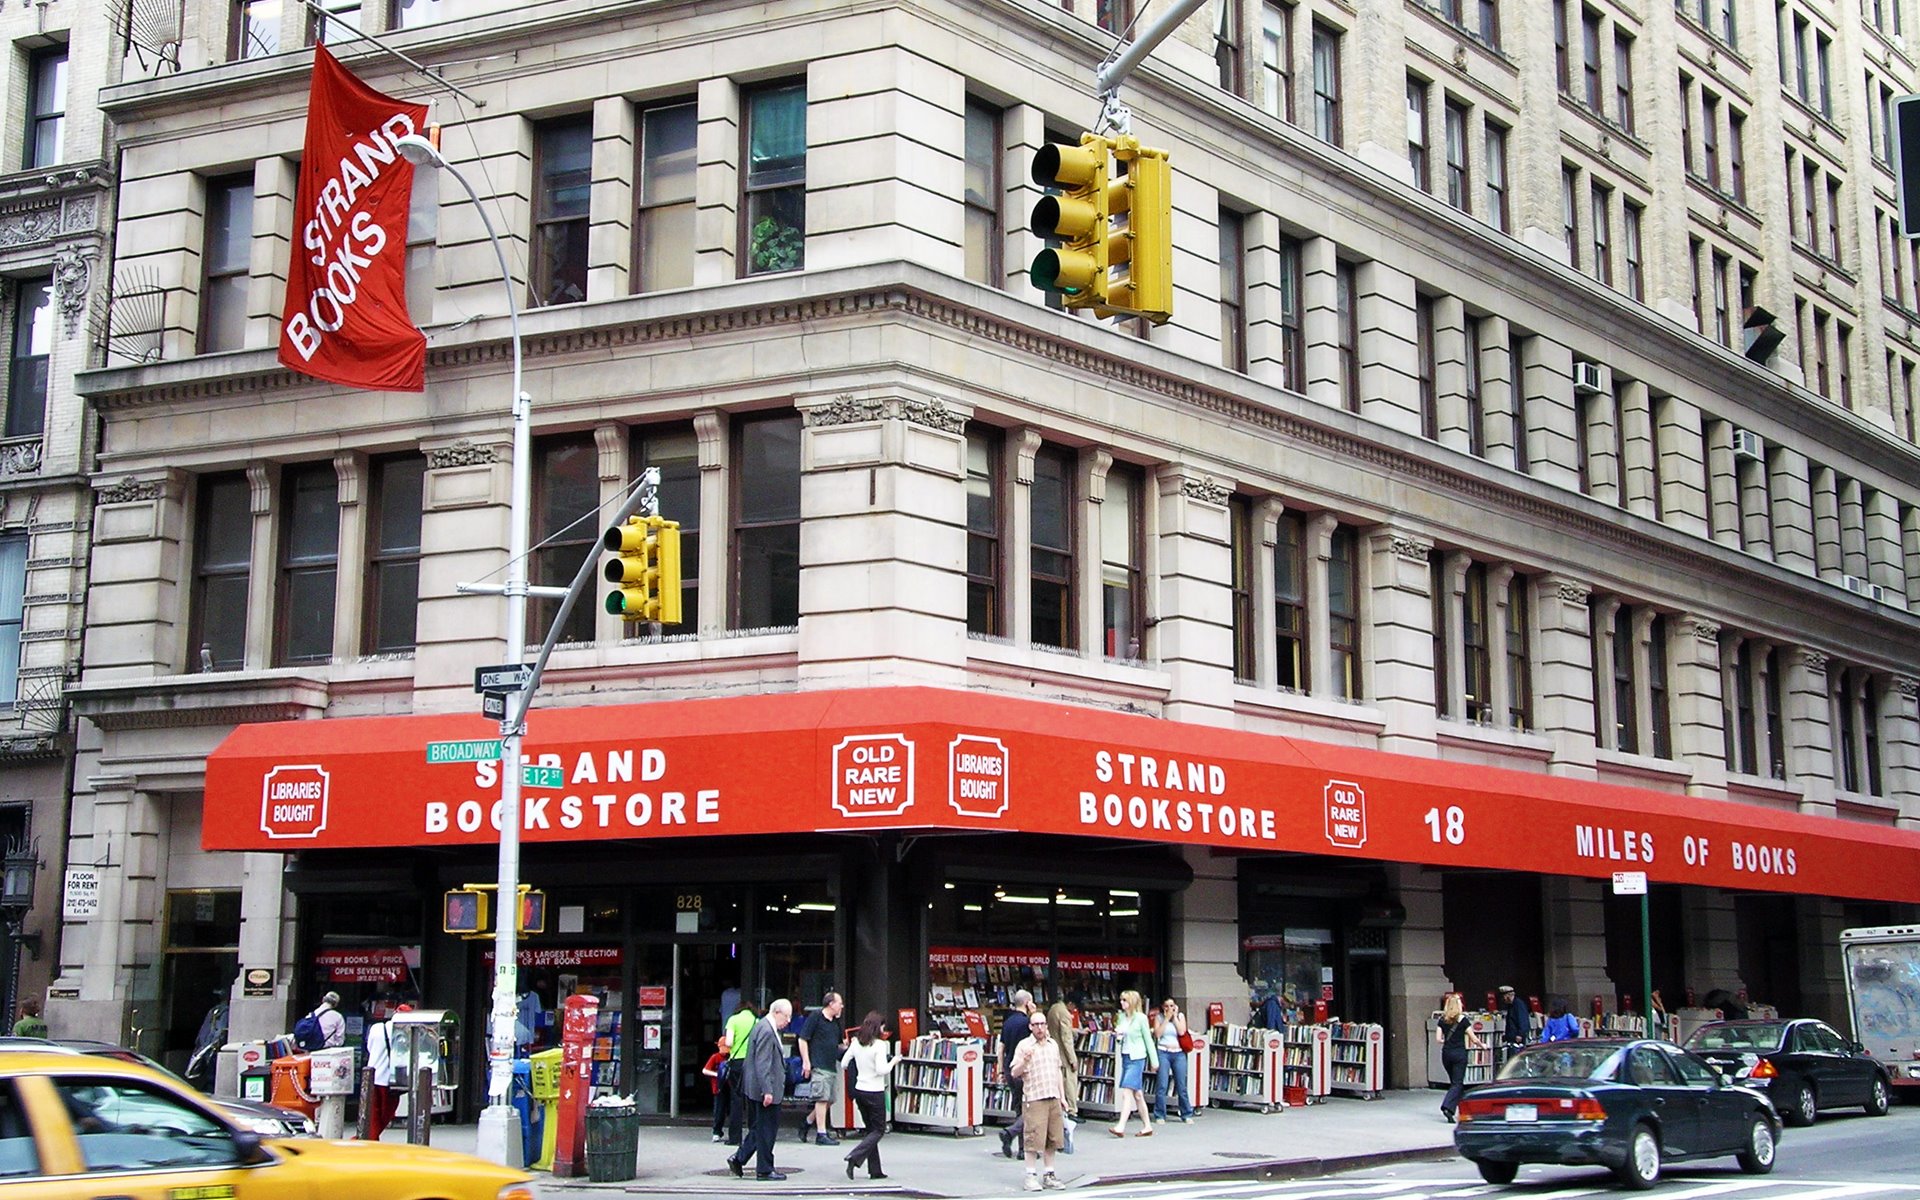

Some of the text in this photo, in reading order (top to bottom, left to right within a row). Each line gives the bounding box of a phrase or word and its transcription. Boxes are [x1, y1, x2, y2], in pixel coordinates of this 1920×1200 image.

[302, 112, 416, 267] STRAND
[286, 210, 387, 362] BOOKS
[482, 671, 531, 685] ONE WAY
[486, 699, 501, 712] ONE
[431, 741, 498, 761] BROADWAY
[852, 745, 895, 764] OLD
[956, 753, 1002, 777] LIBRARIES
[1095, 750, 1226, 795] STRAND
[522, 769, 560, 785] E 12 ST
[845, 766, 902, 785] RARE
[271, 781, 321, 800] LIBRARIES
[849, 787, 897, 806] NEW
[960, 778, 998, 800] BOUGHT
[1334, 789, 1356, 805] OLD
[273, 804, 315, 823] BOUGHT
[1079, 791, 1277, 840] BOOKSTORE
[1330, 806, 1361, 822] RARE
[1334, 823, 1358, 839] NEW
[1424, 805, 1797, 875] 18 MILES OF BOOKS
[67, 881, 98, 889] FOR RENT
[676, 895, 702, 909] 828
[344, 956, 369, 964] BOOKS
[534, 950, 570, 959] LARGEST
[574, 949, 618, 958] SELECTION
[554, 958, 581, 966] BOOKS
[951, 954, 968, 963] USED
[970, 954, 987, 963] BOOK
[988, 955, 1008, 964] STORE
[1016, 956, 1028, 964] THE
[1029, 956, 1051, 965] WORLD
[335, 967, 401, 976] OPEN SEVEN DAYS
[1070, 961, 1082, 970] OLD
[1083, 962, 1095, 970] AND
[1096, 962, 1110, 970] RARE
[1111, 962, 1129, 971] BOOKS
